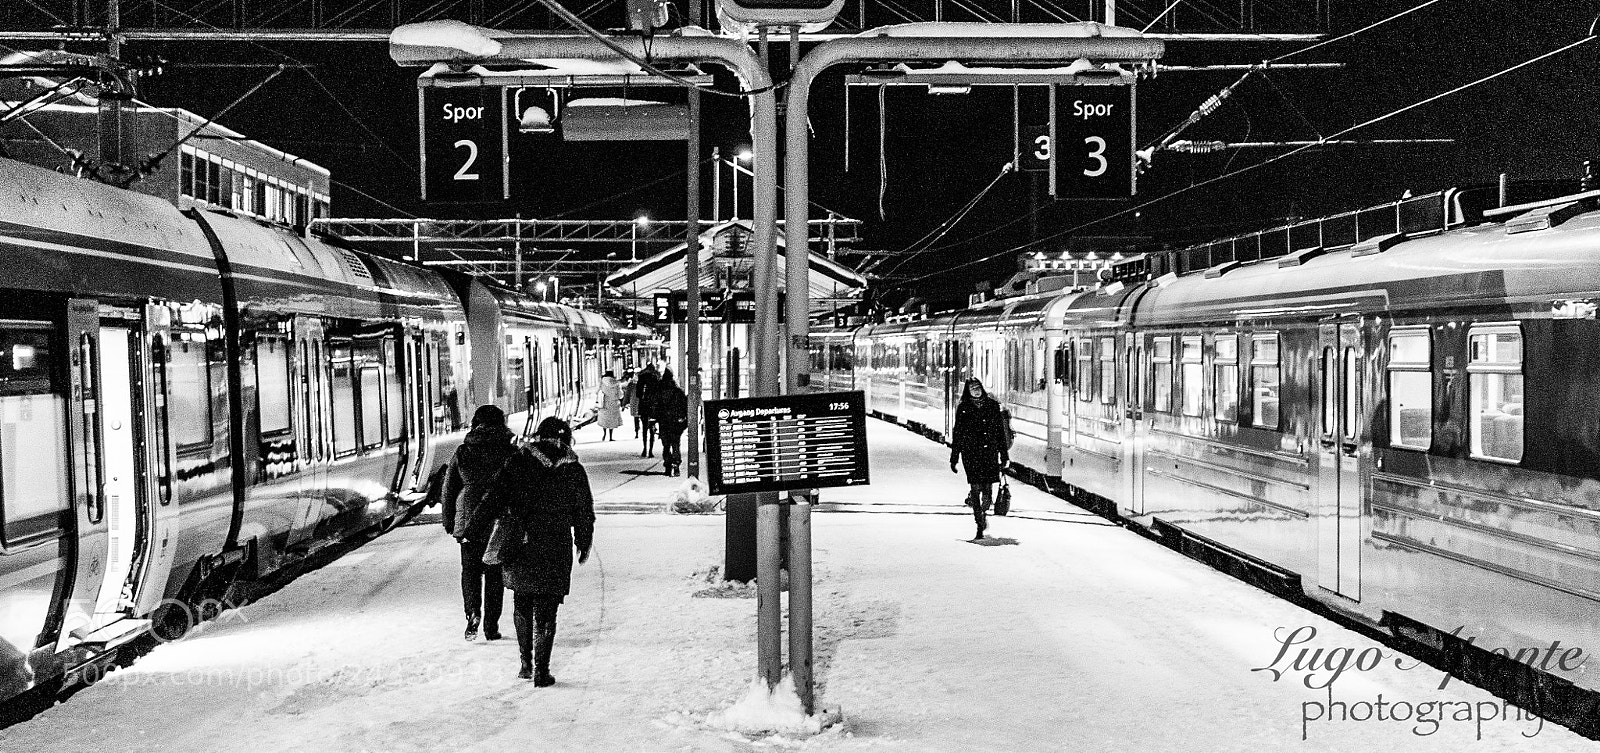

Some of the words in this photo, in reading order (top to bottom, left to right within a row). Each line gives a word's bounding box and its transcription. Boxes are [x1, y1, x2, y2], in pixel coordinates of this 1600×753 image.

[443, 103, 484, 123] Spor
[1073, 100, 1114, 120] Spor
[1034, 135, 1050, 160] 3
[453, 139, 480, 181] 2
[1083, 135, 1108, 177] 3
[658, 307, 667, 320] 2
[627, 319, 633, 328] 2
[838, 317, 844, 327] 3
[755, 407, 791, 416] Departures
[829, 402, 849, 411] 17:56
